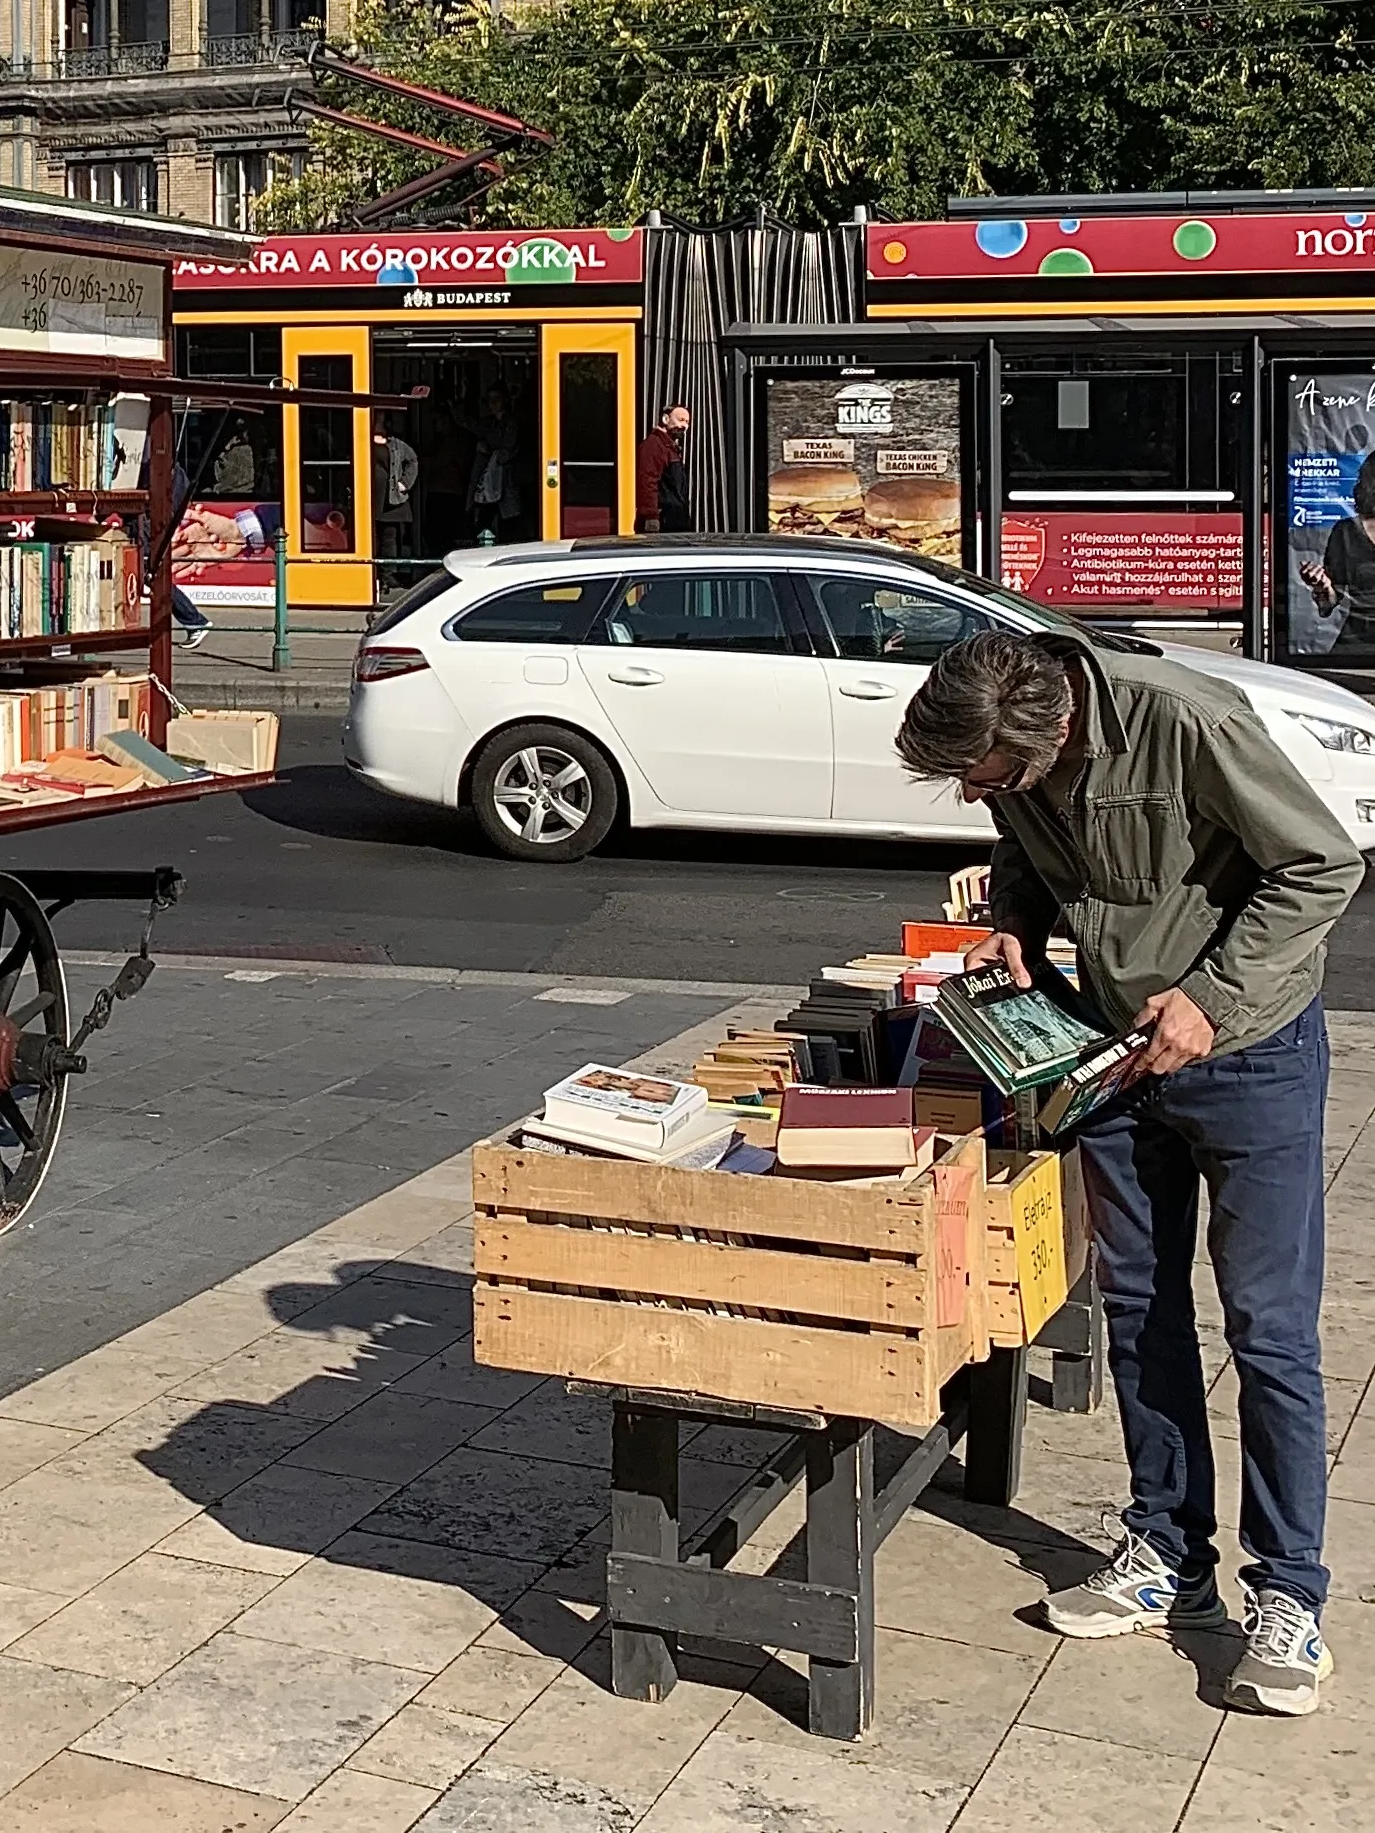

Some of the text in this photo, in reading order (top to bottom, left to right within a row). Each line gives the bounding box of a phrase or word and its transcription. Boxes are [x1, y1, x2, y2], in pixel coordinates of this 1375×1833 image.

[1295, 229, 1375, 256] nor
[308, 255, 331, 272] A
[340, 240, 606, 272] KÓROKOZÓKKAL
[21, 268, 144, 309] +36 70/363-2287
[437, 292, 512, 305] BUDAPEST
[21, 302, 47, 333] +36
[1294, 378, 1321, 415] A
[1322, 395, 1361, 409] zene
[838, 405, 892, 423] KINGS
[793, 450, 845, 459] BACON KING
[885, 453, 938, 461] TEXAS CHICKEN
[885, 462, 938, 471] BACON KING
[1295, 458, 1338, 467] NEMZETI
[1070, 532, 1243, 545] Kifejezetten felnőttek számára
[1070, 546, 1152, 558] Legmagasabb
[1070, 557, 1243, 570] Antibiotikum-kúra esetén kett
[1125, 571, 1203, 583] hozzájárulhat
[1206, 573, 1215, 583] a
[189, 590, 269, 603] KEZELŐORVOSÁT,
[1070, 584, 1100, 595] Akut
[1168, 584, 1208, 596] esetén
[962, 972, 996, 999] Jókai
[1023, 1191, 1053, 1232] Életrajz
